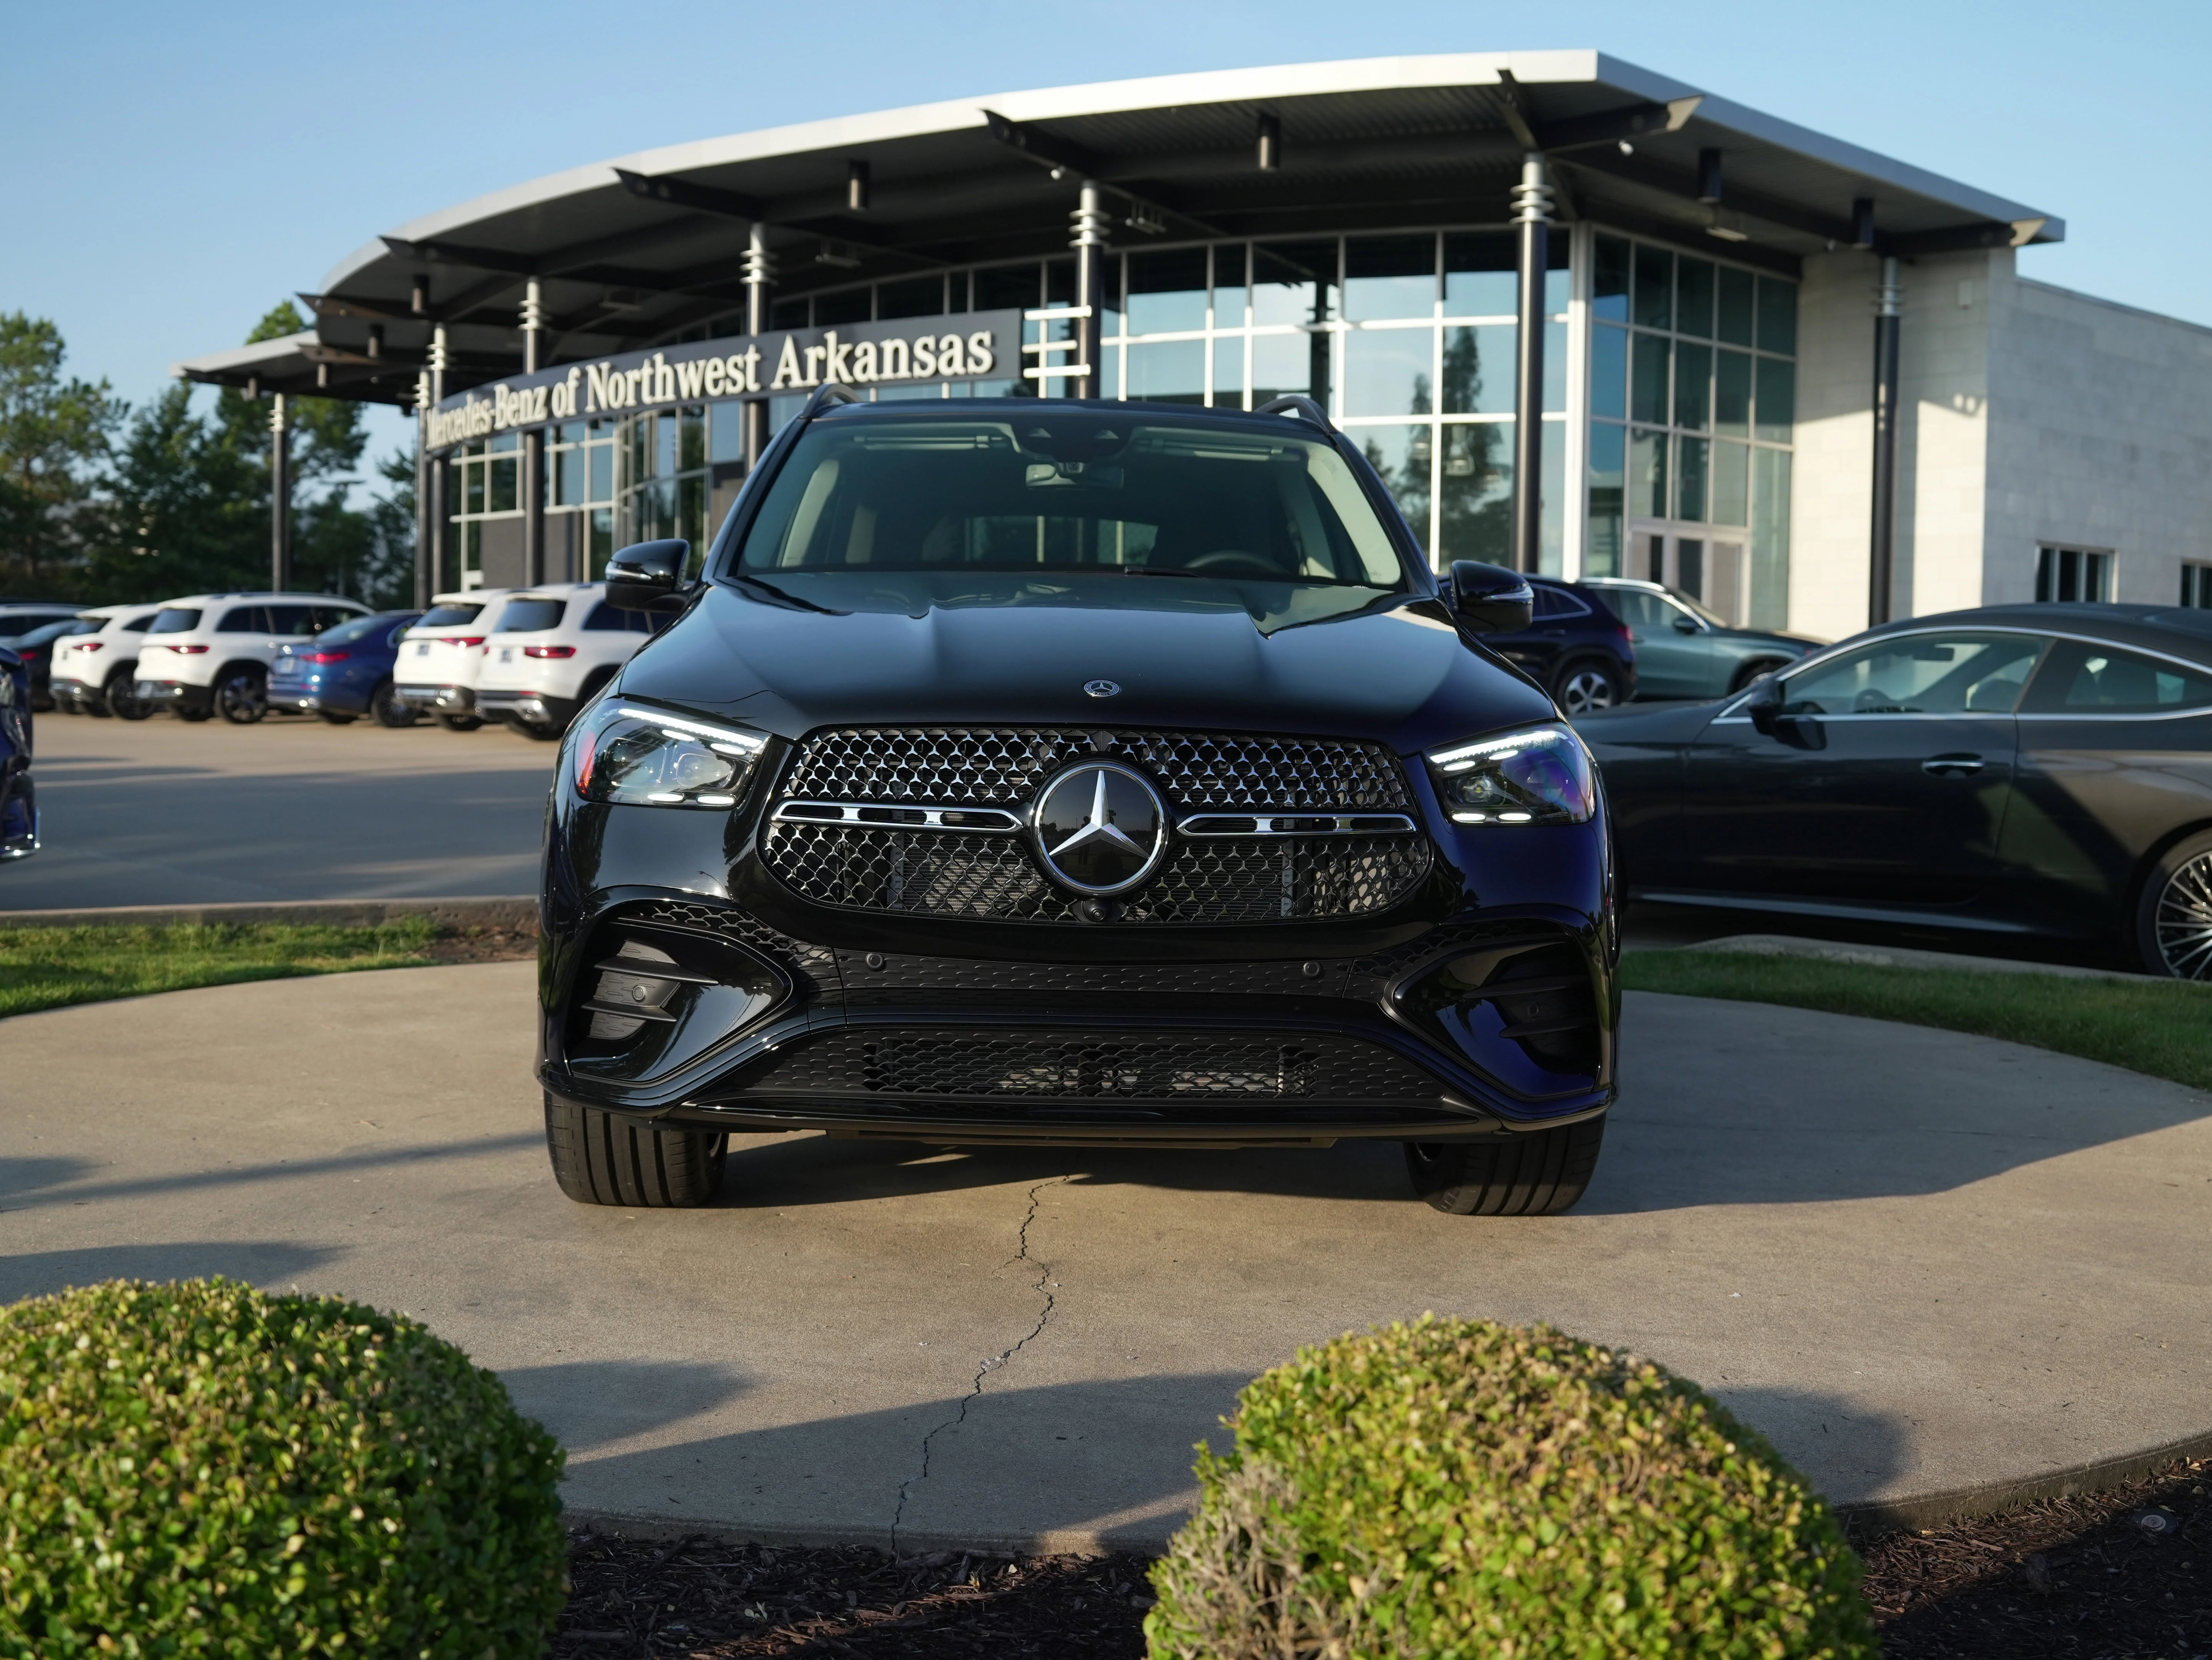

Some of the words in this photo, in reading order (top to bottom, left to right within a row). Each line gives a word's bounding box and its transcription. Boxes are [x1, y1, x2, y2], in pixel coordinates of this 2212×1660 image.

[426, 383, 548, 450] Mercedes-Benz
[552, 367, 581, 418] of
[585, 344, 762, 413] Northwest
[770, 330, 993, 389] Arkansas
